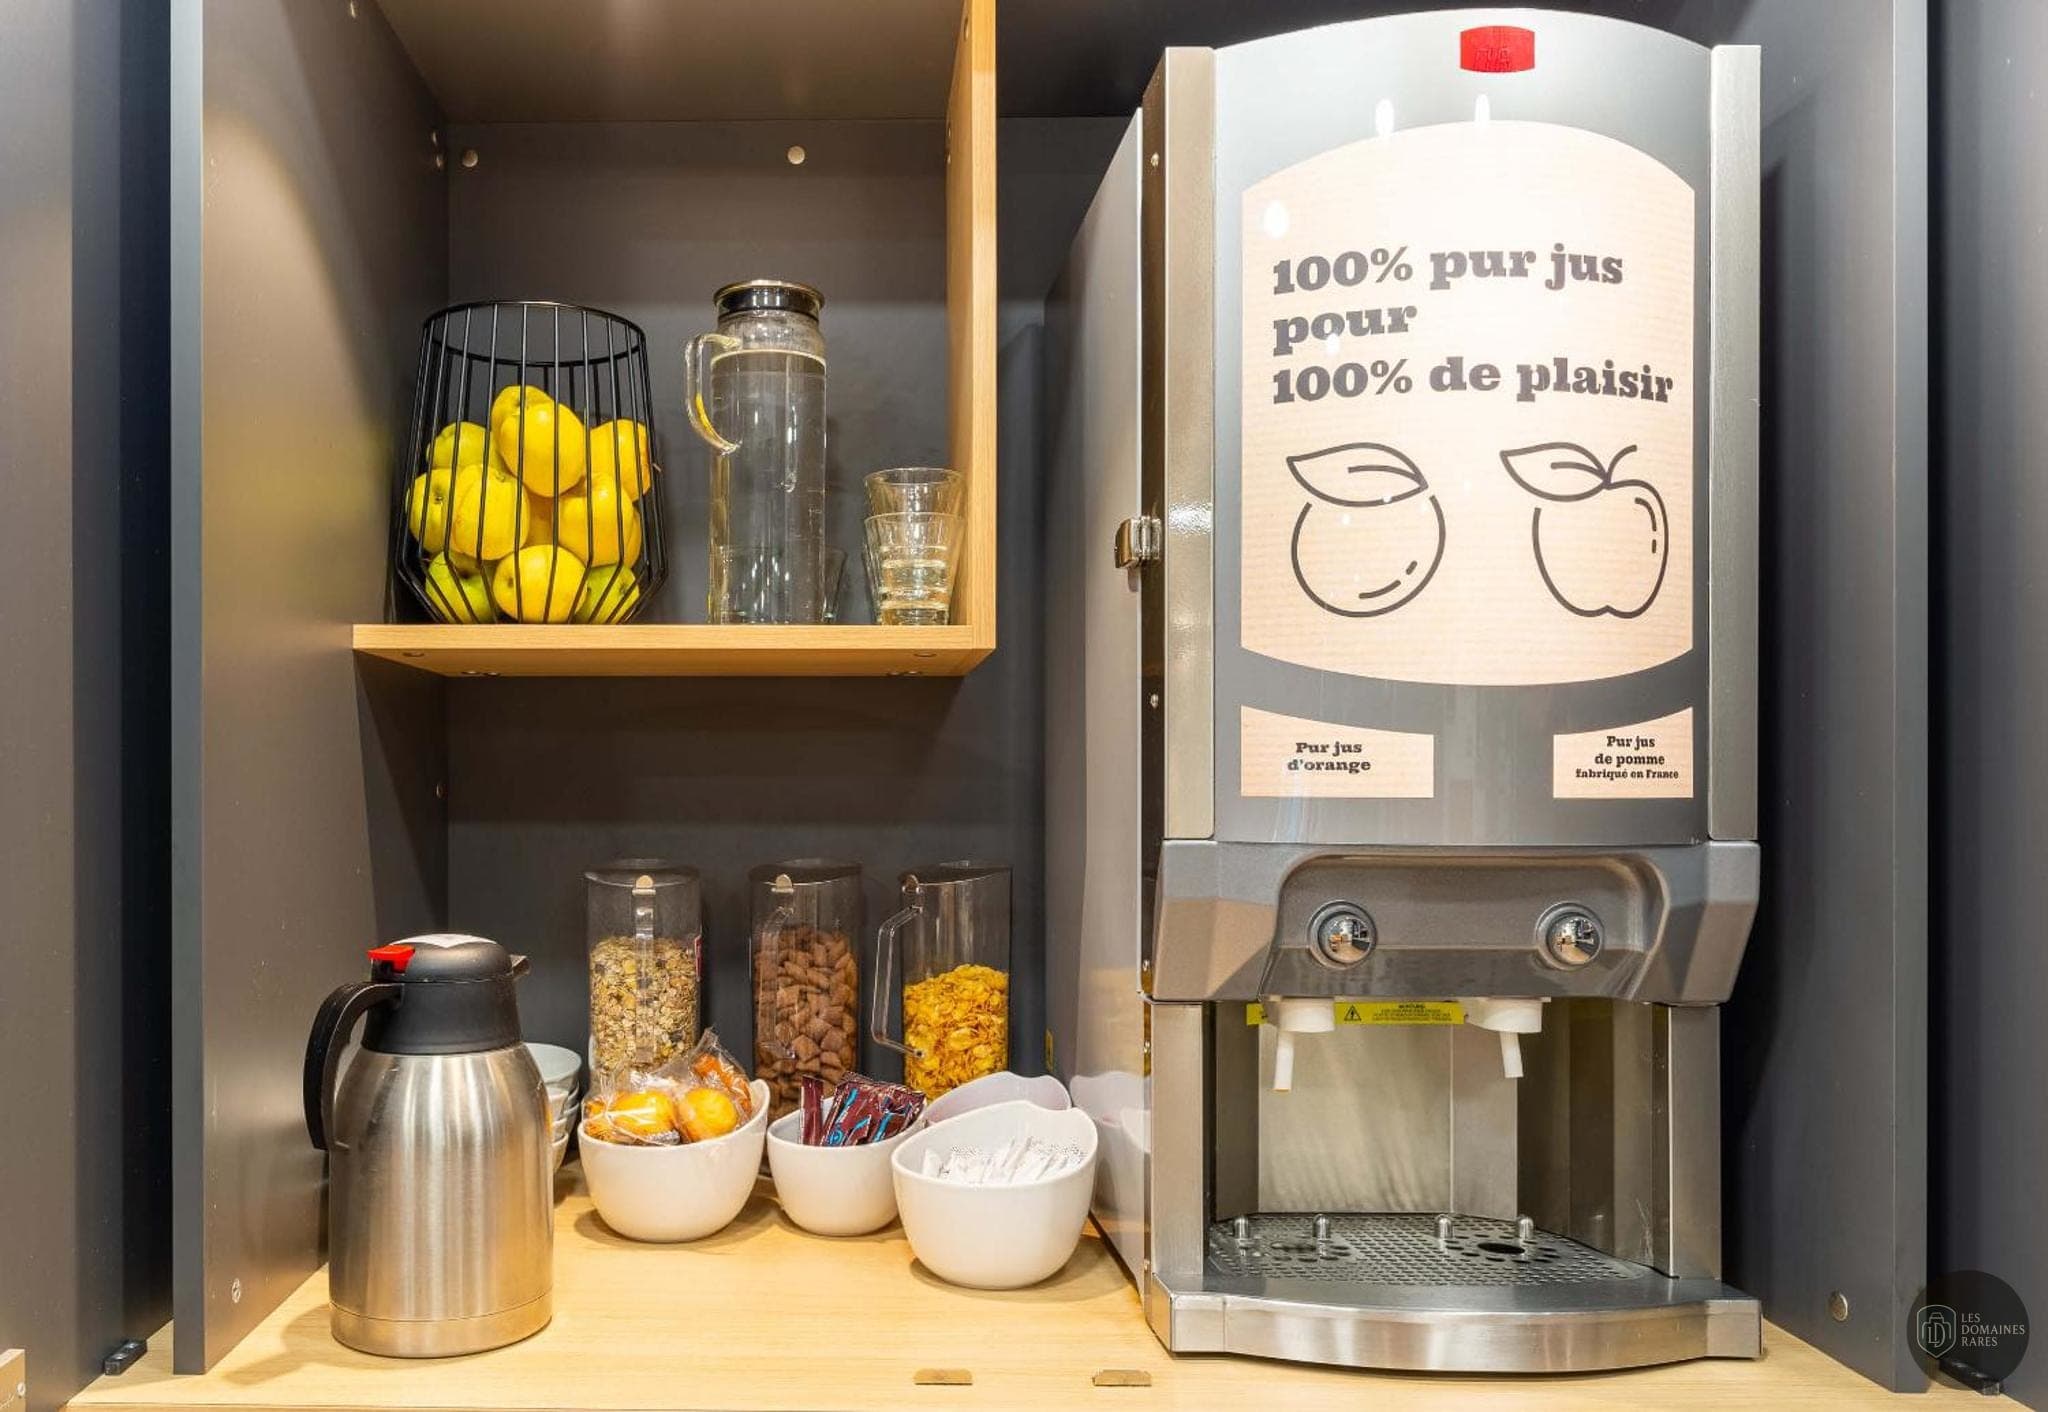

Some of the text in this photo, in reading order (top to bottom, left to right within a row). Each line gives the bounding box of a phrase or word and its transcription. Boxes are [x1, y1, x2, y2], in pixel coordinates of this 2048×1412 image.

[1273, 243, 1623, 294] 100% pur jus
[1273, 305, 1417, 356] pour
[1273, 356, 1673, 403] 100% de plaisir
[1296, 741, 1362, 757] Pur jus
[1606, 735, 1655, 751] Pur jus
[1287, 759, 1371, 774] d'orange
[1594, 753, 1665, 768] de pomme
[1576, 768, 1679, 780] fabriqué en France
